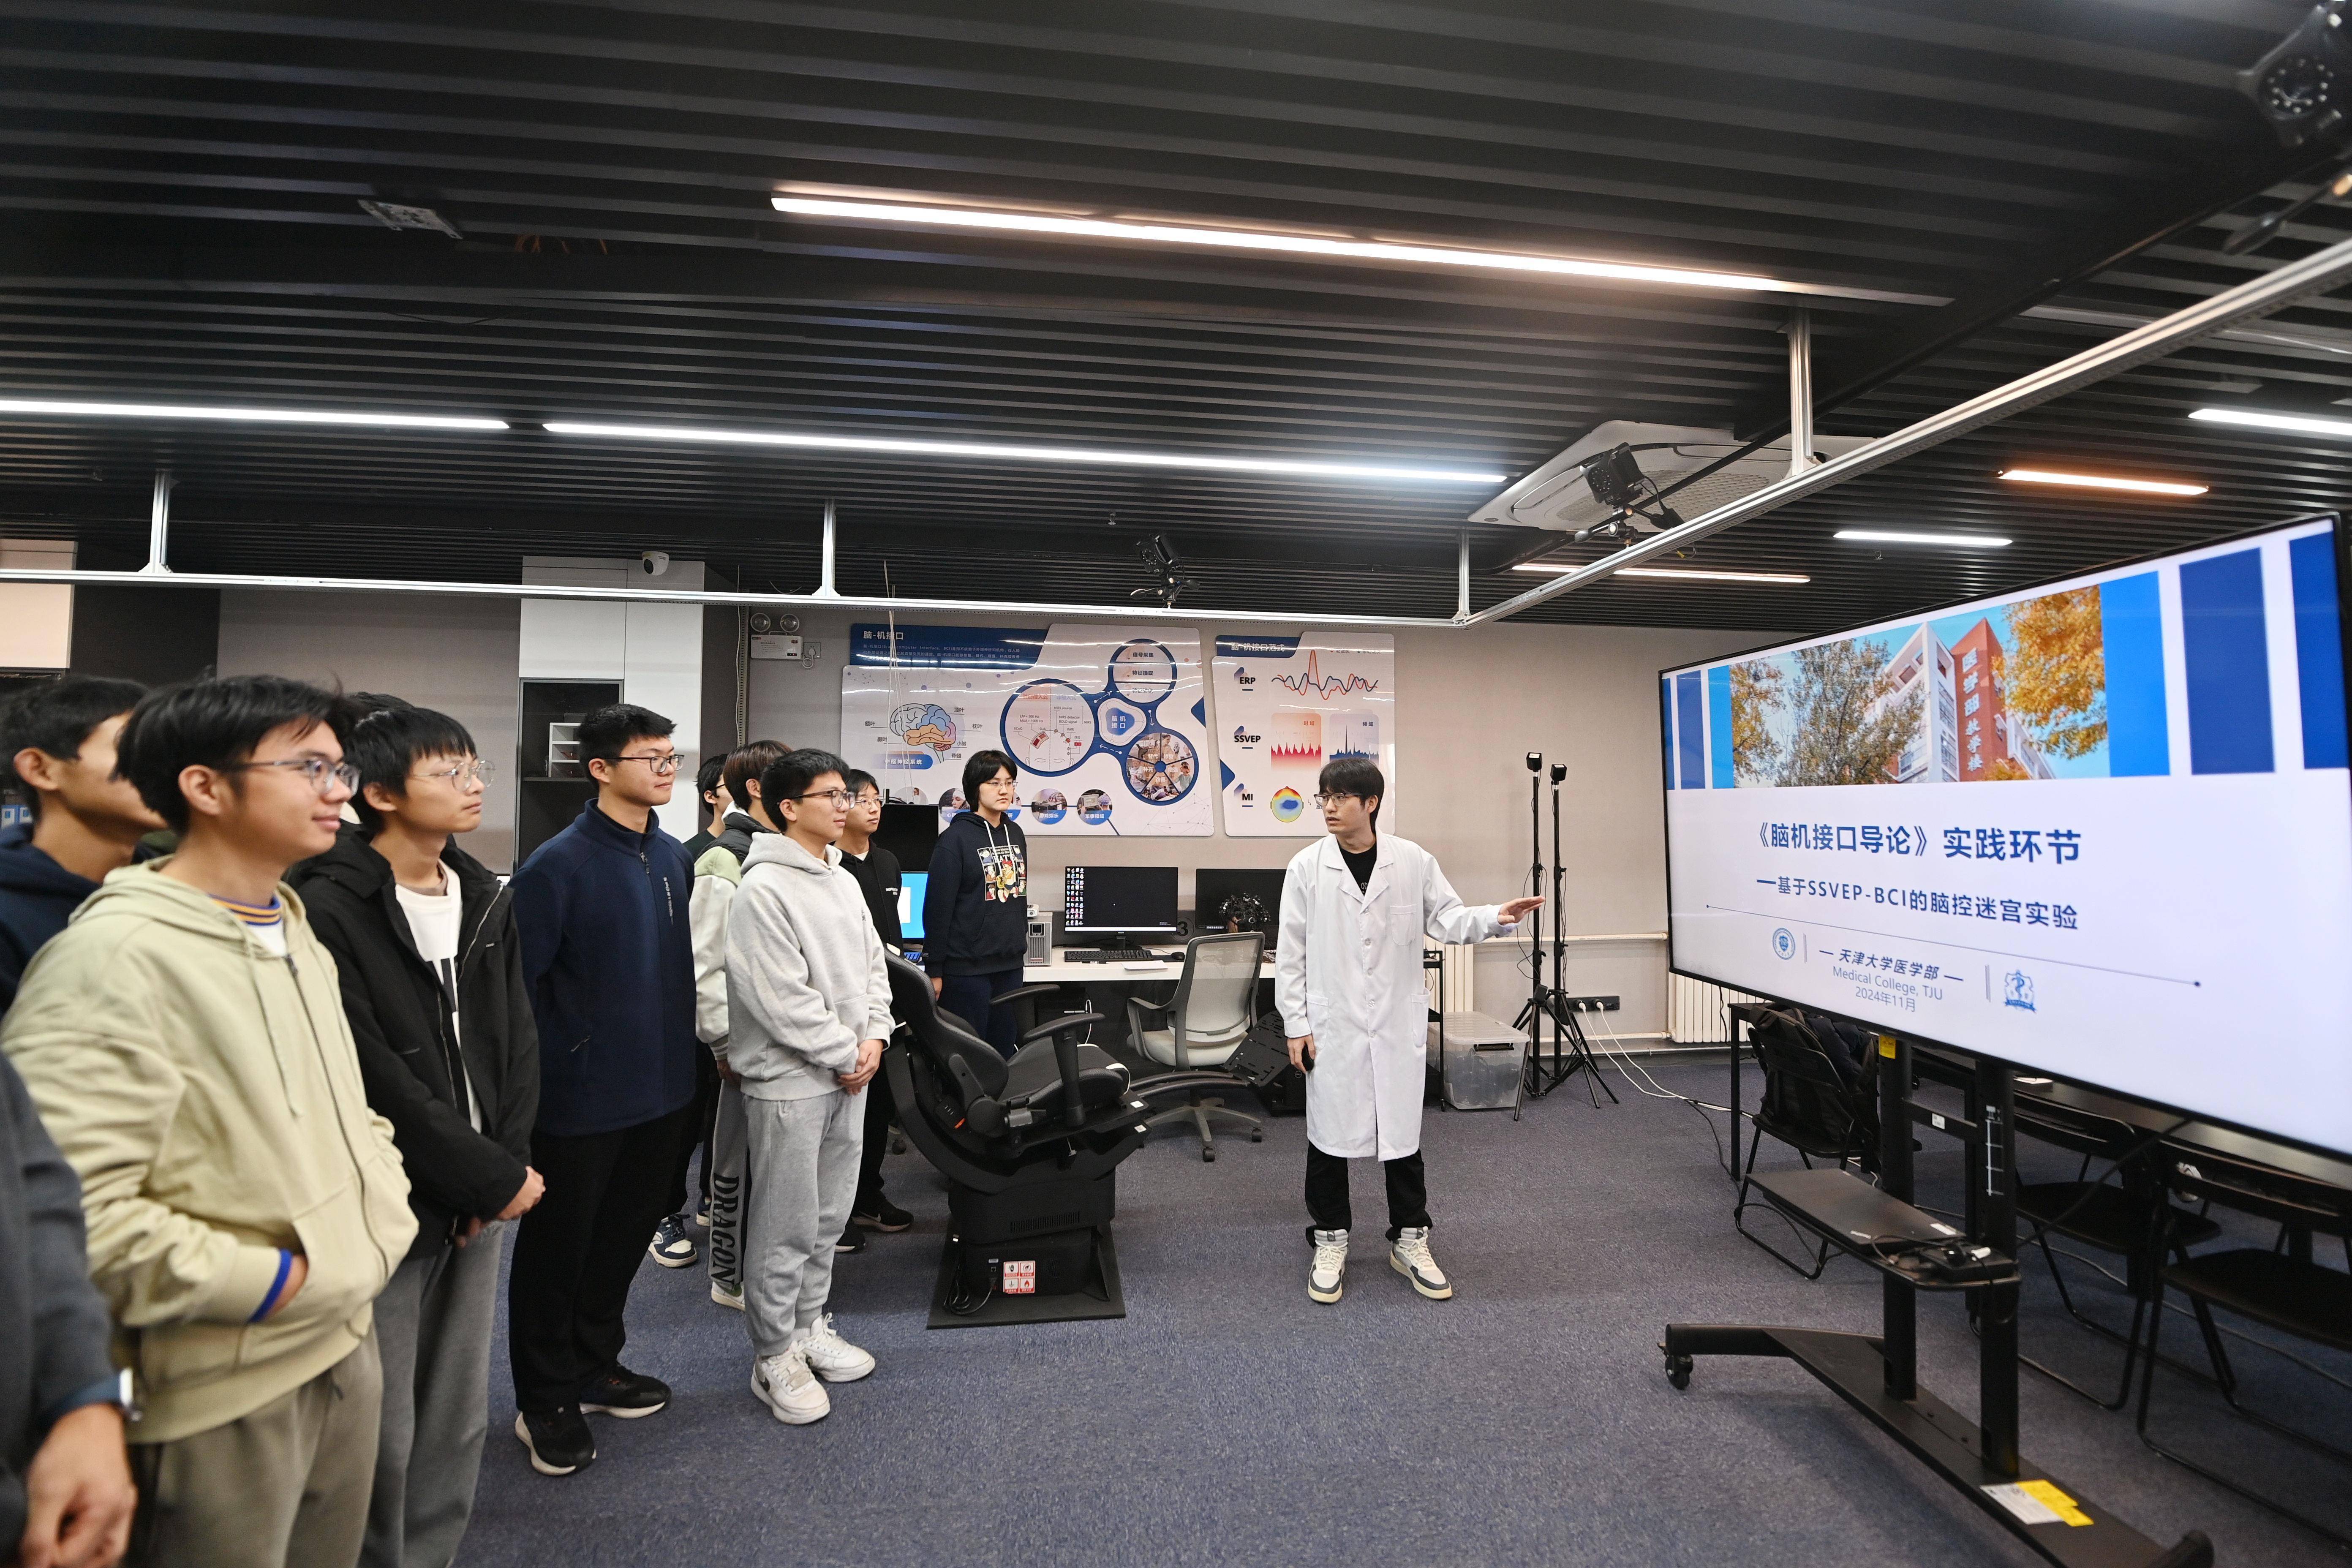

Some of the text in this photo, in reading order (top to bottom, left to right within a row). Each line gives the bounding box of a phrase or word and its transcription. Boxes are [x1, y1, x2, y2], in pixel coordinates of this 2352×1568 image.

[1239, 677, 1256, 685] ERP
[1177, 921, 1189, 936] 3
[1832, 966, 1943, 1000] Medical College, TJU
[1855, 986, 1916, 1013] 2024年11月
[710, 1174, 740, 1286] DRAGON
